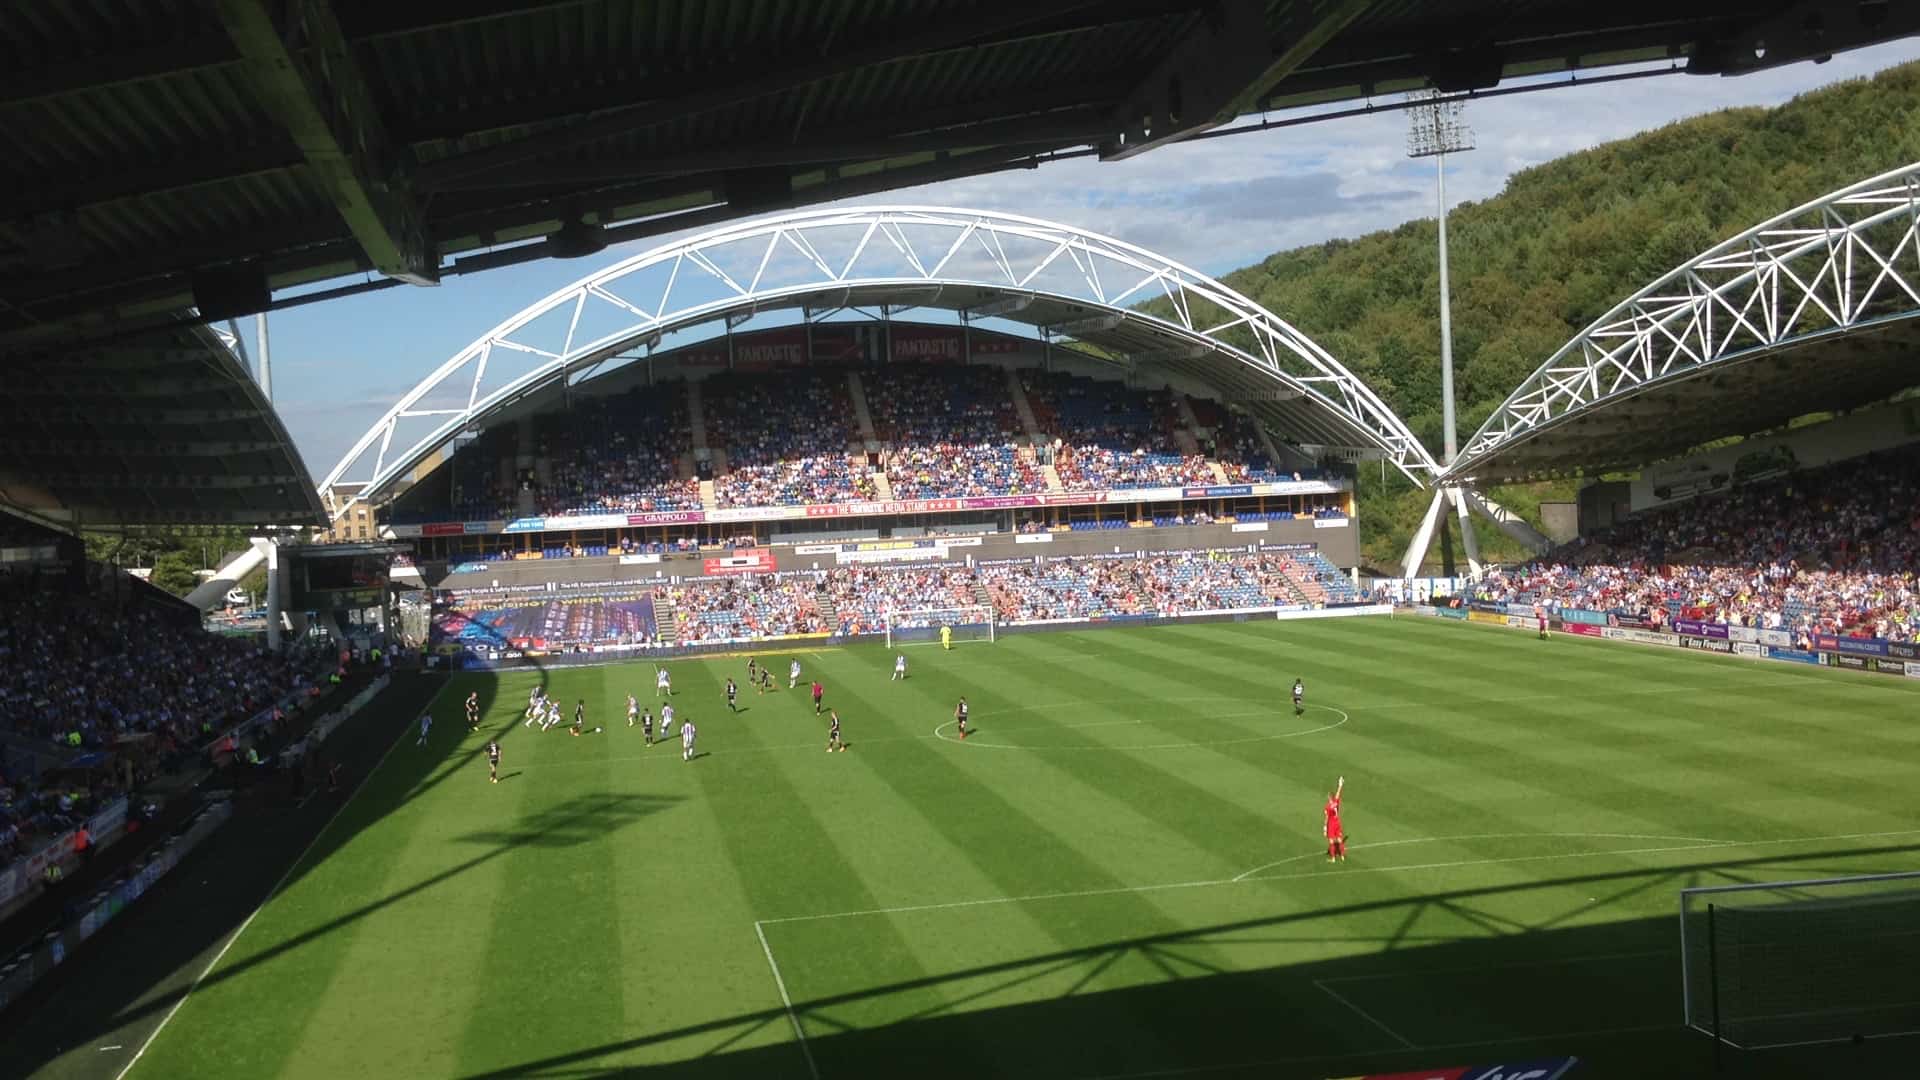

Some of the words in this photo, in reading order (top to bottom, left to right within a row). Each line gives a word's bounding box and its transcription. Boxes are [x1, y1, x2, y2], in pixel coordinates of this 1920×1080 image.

[737, 344, 801, 363] FANTASTIC
[895, 337, 959, 357] FANTASTIC
[836, 505, 849, 514] THE
[886, 502, 905, 512] MEDIA
[906, 501, 928, 511] STAND
[644, 513, 688, 523] GRAPPOLO
